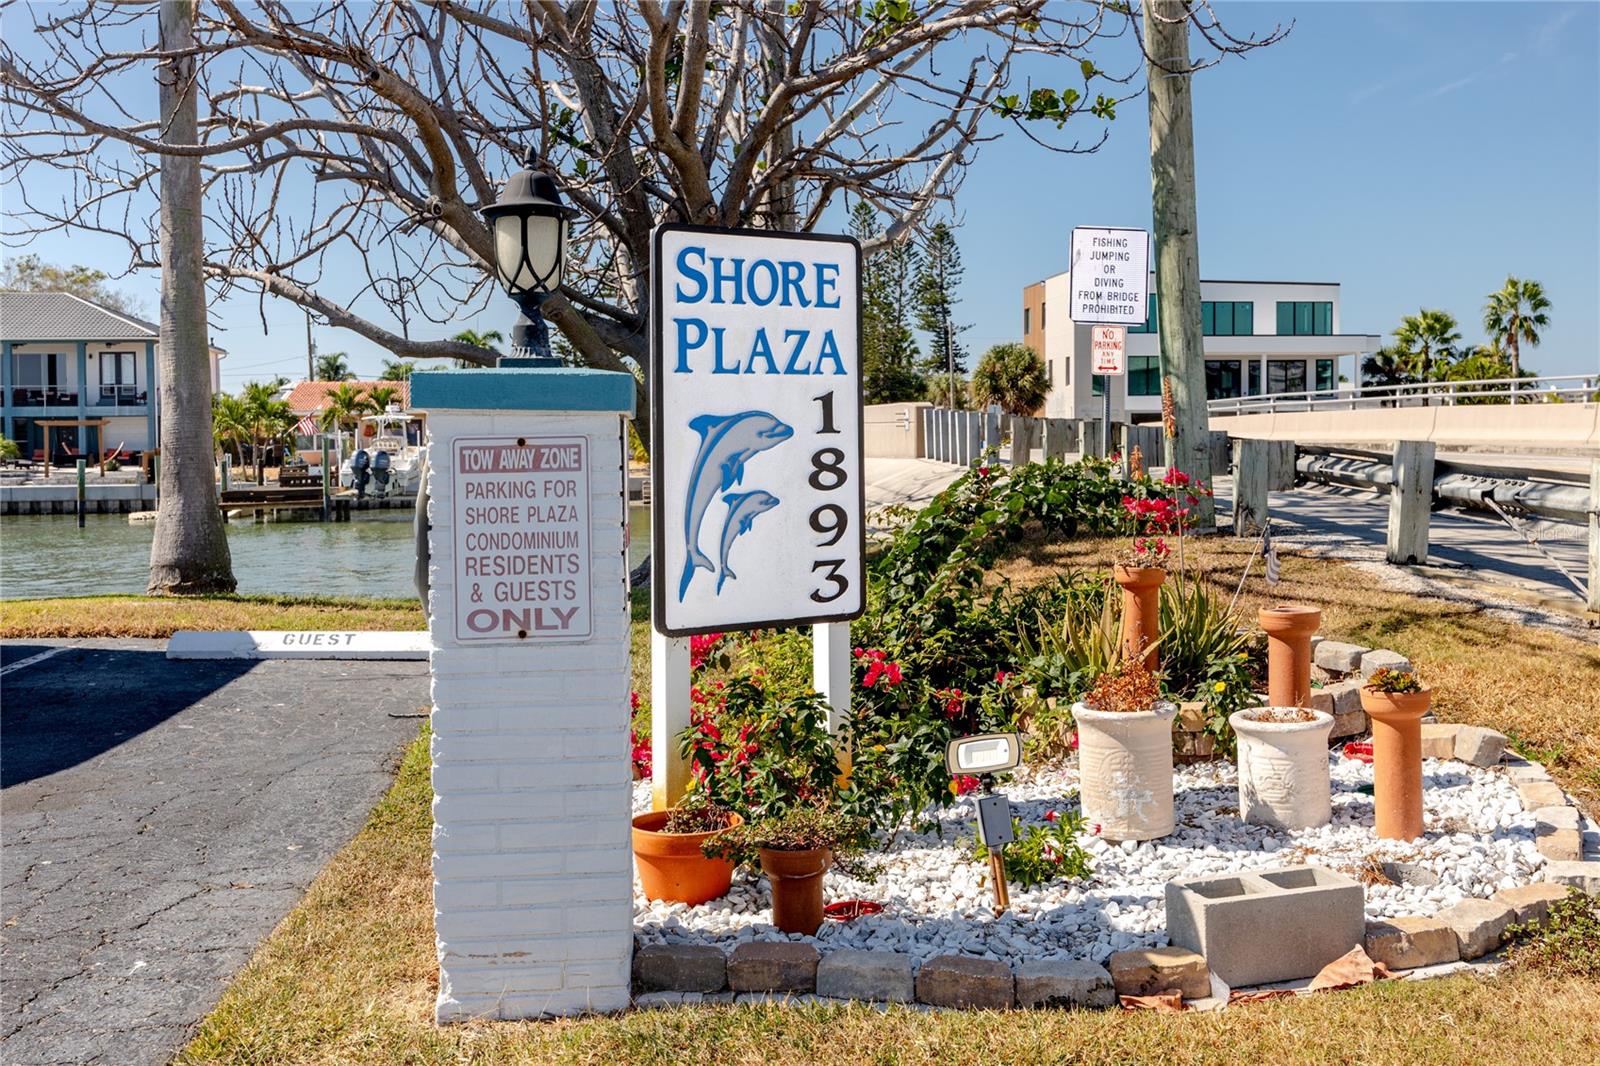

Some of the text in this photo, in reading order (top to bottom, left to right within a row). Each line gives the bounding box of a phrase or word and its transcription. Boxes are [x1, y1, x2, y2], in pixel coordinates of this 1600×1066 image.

[1092, 237, 1128, 248] FISHING
[1090, 251, 1130, 262] JUMPING
[1103, 264, 1116, 274] OR
[675, 246, 841, 309] SHORE
[1094, 278, 1124, 288] DIVING
[1078, 290, 1139, 302] FROM BRIDGE
[1082, 304, 1135, 315] PROHIBITED
[1102, 330, 1115, 340] NO
[673, 317, 848, 376] PLAZA
[1094, 341, 1122, 351] PARKING
[462, 447, 579, 471] TOW AWAY ZONE
[465, 479, 577, 500] PARKING FOR
[465, 505, 579, 525] SHORE PLAZA
[465, 530, 579, 552] CONDOMINIUM
[465, 553, 580, 577] RESIDENTS
[470, 580, 576, 603] & GUESTS
[466, 606, 580, 633] ONLY
[282, 633, 356, 646] GUEST
